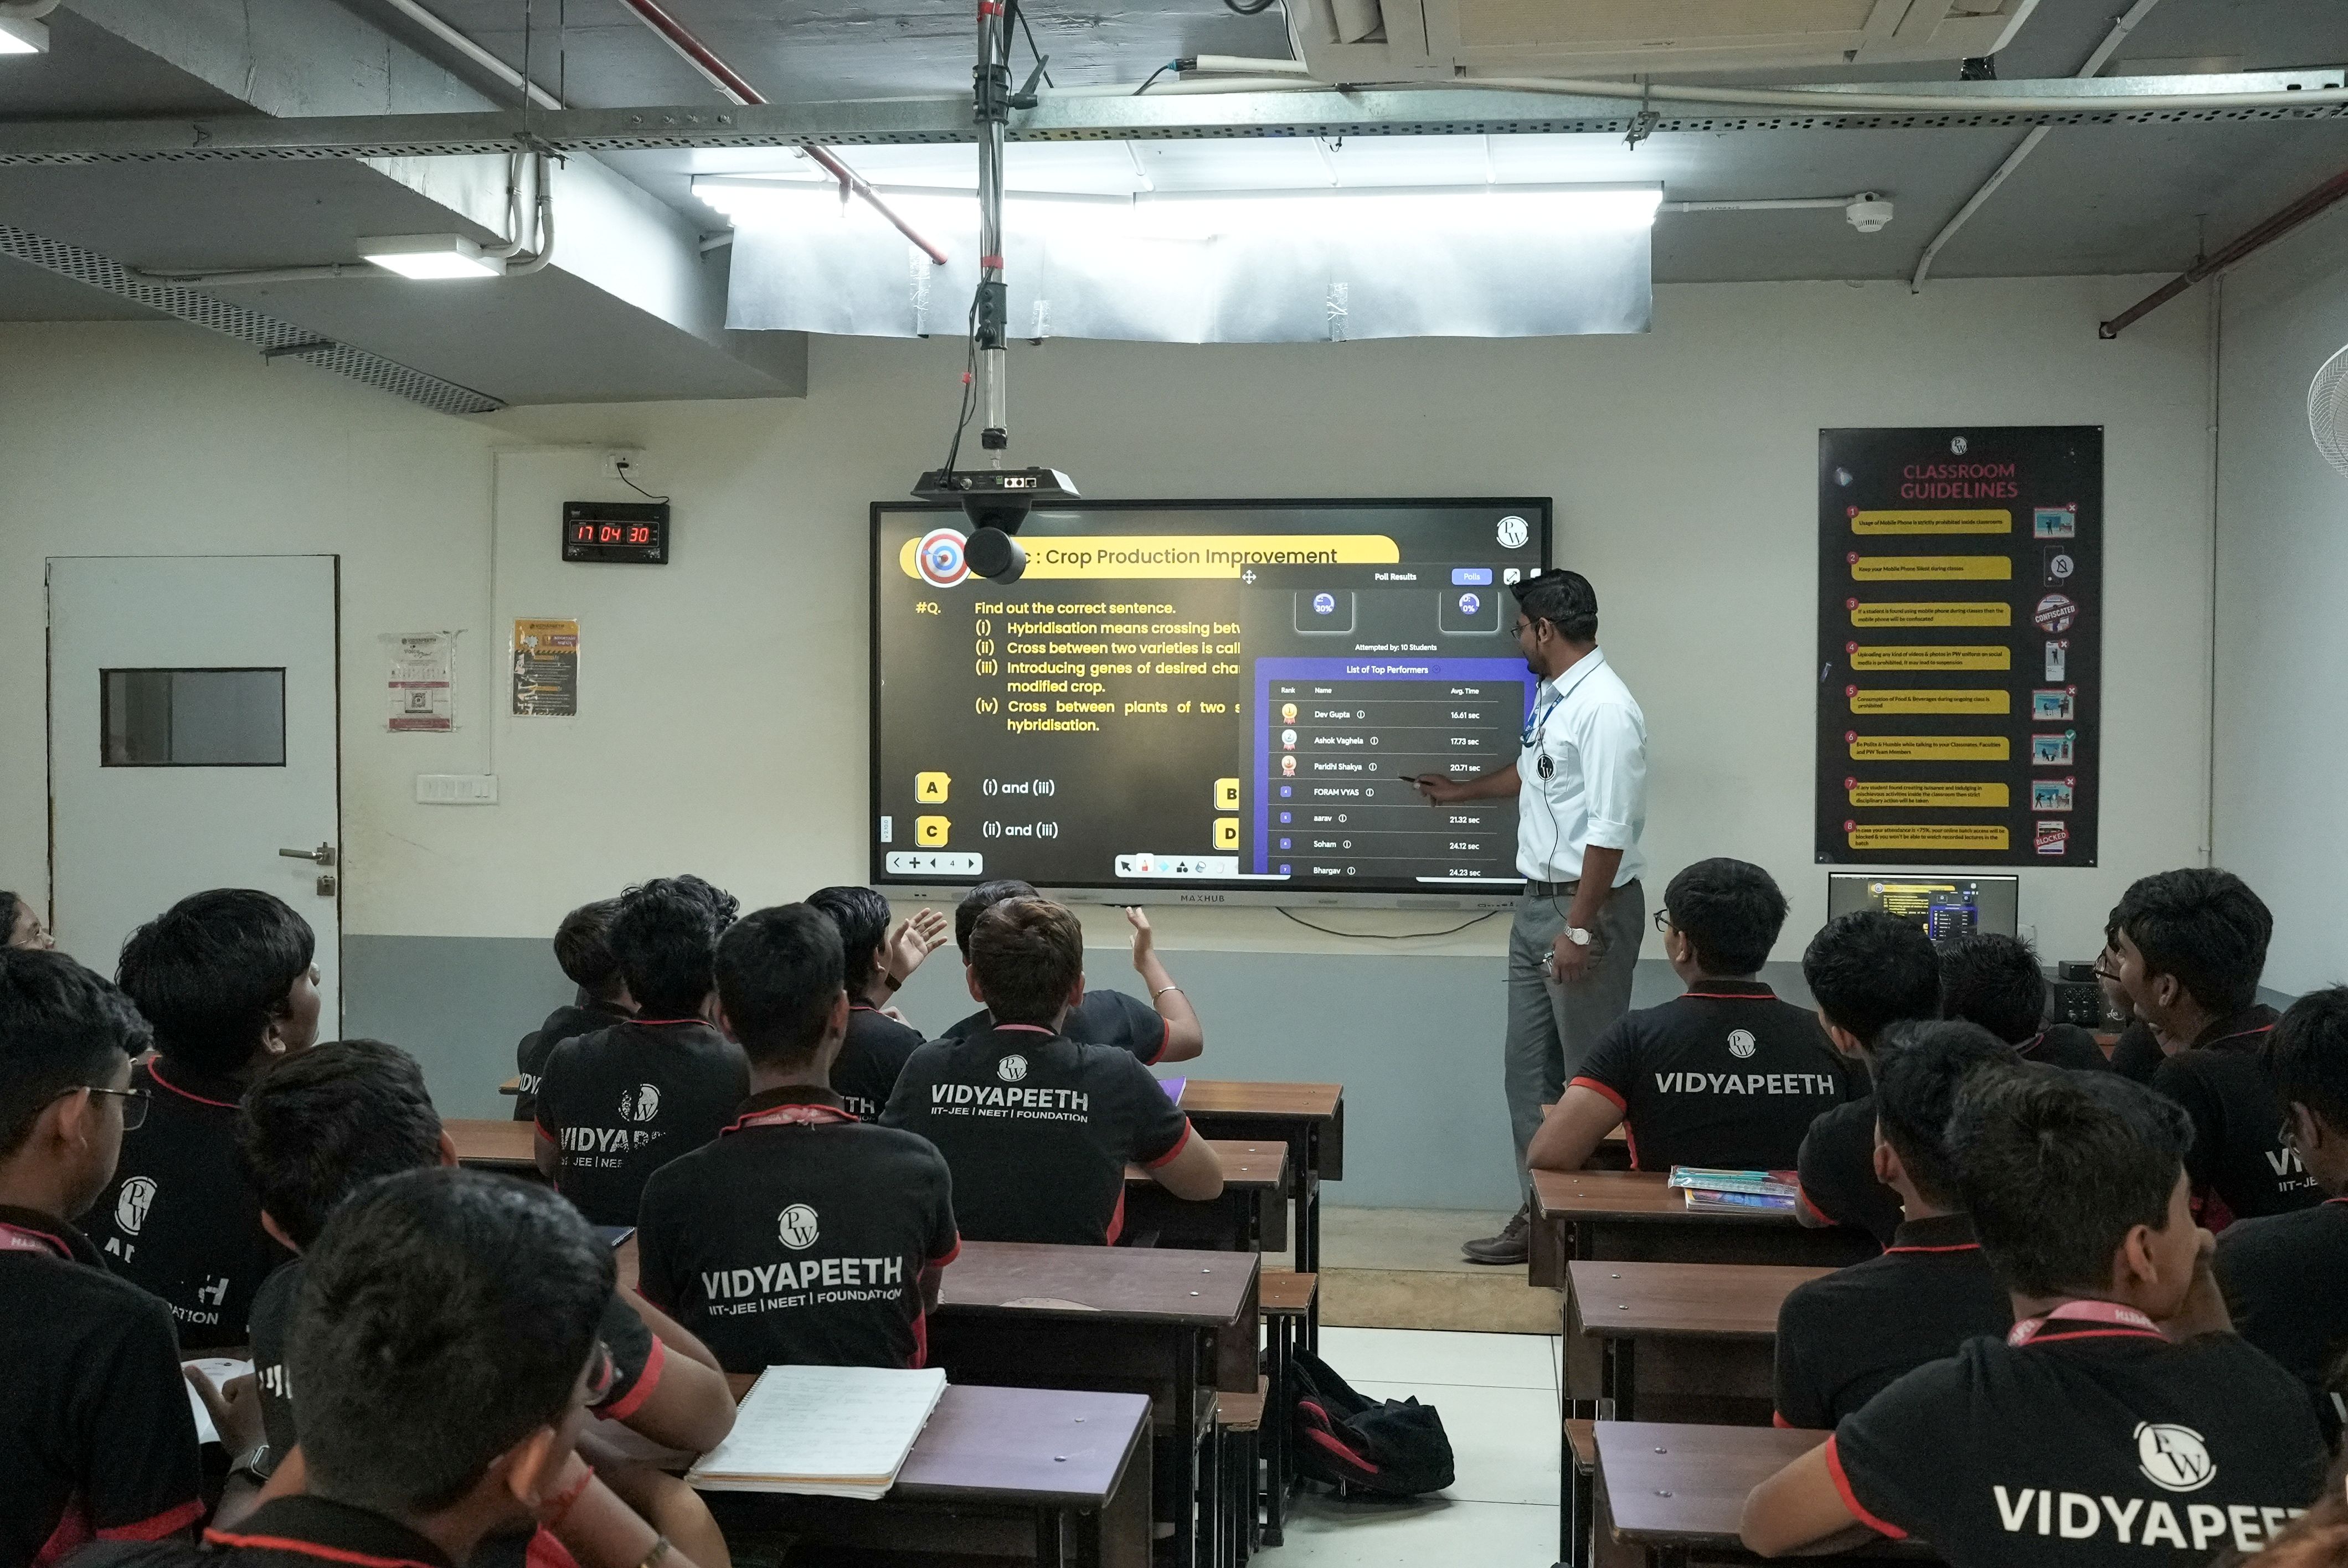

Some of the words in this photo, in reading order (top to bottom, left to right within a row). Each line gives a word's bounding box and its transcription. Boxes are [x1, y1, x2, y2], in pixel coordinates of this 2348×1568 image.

[1904, 463, 2015, 478] CLASSROOM
[1901, 482, 2018, 498] GUIDELINES
[578, 526, 593, 540] 17
[601, 526, 621, 542] 04
[629, 528, 648, 542] 30
[1046, 550, 1091, 569] Crop
[1098, 549, 1199, 564] Production
[1206, 548, 1337, 569] Improvement
[916, 602, 941, 615] #Q.
[975, 602, 1003, 614] Find
[1006, 602, 1029, 614] out
[1032, 602, 1054, 614] the
[1057, 602, 1106, 614] correct
[1109, 602, 1176, 614] sentence.
[2035, 605, 2076, 624] CONFISCATED
[976, 620, 991, 635] (i)
[1008, 622, 1097, 636] Hybridisation
[1101, 625, 1148, 634] means
[1151, 622, 1210, 636] crossing
[976, 640, 994, 656] (ii)
[1007, 642, 1046, 654] Cross
[1049, 642, 1108, 654] between
[1111, 644, 1136, 654] two
[1139, 642, 1198, 654] varieties
[1201, 643, 1213, 654] is
[1355, 644, 1389, 652] Attempted
[1401, 644, 1408, 652] 10
[1409, 644, 1437, 652] Students
[976, 660, 998, 675] (iii)
[1008, 662, 1085, 676] Introducing
[1090, 664, 1132, 676] genes
[1137, 662, 1152, 674] of
[1155, 662, 1207, 674] desired
[1212, 662, 1239, 674] cha
[1346, 666, 1360, 675] List
[1362, 666, 1369, 675] of
[1371, 666, 1385, 675] Top
[1387, 666, 1429, 675] Performers
[1008, 680, 1067, 693] modified
[1070, 682, 1105, 695] crop.
[976, 699, 998, 714] (iv)
[1008, 700, 1047, 712] Cross
[1056, 700, 1115, 712] between
[1125, 701, 1168, 715] plants
[1177, 701, 1191, 713] of
[1200, 703, 1226, 713] two
[1315, 710, 1327, 719] Dev
[1330, 710, 1350, 719] Gupta
[1008, 719, 1100, 734] hybridisation.
[1314, 736, 1334, 745] Ashok
[1336, 736, 1363, 746] Vaghela
[1314, 762, 1337, 771] Paridhi
[1338, 762, 1362, 772] Shakya
[926, 782, 938, 793] A
[983, 780, 997, 795] (i)
[1002, 782, 1028, 793] and
[1032, 780, 1055, 796] (iii)
[1227, 788, 1237, 800] B
[1314, 788, 1339, 796] FORAM
[1340, 788, 1360, 796] VYAS
[926, 826, 938, 838] C
[983, 821, 1001, 838] (ii)
[1005, 824, 1032, 835] and
[1036, 822, 1058, 838] (iii)
[1226, 828, 1236, 839] D
[2036, 832, 2066, 847] BLOCKED
[1313, 866, 1341, 875] Bhargav
[1655, 1072, 1834, 1095] VIDYAPEETH
[931, 1084, 1088, 1111] VIDYAPEETH
[931, 1106, 970, 1116] IIT-JEE
[978, 1109, 1009, 1117] NEET
[1016, 1111, 1088, 1123] FOUNDATION
[2278, 1176, 2319, 1192] IIT-JE
[702, 1256, 903, 1301] VIDYAPEETH
[709, 1301, 757, 1316] IIT-JEE
[768, 1294, 806, 1309] NEET
[817, 1288, 902, 1304] FOUNDATION
